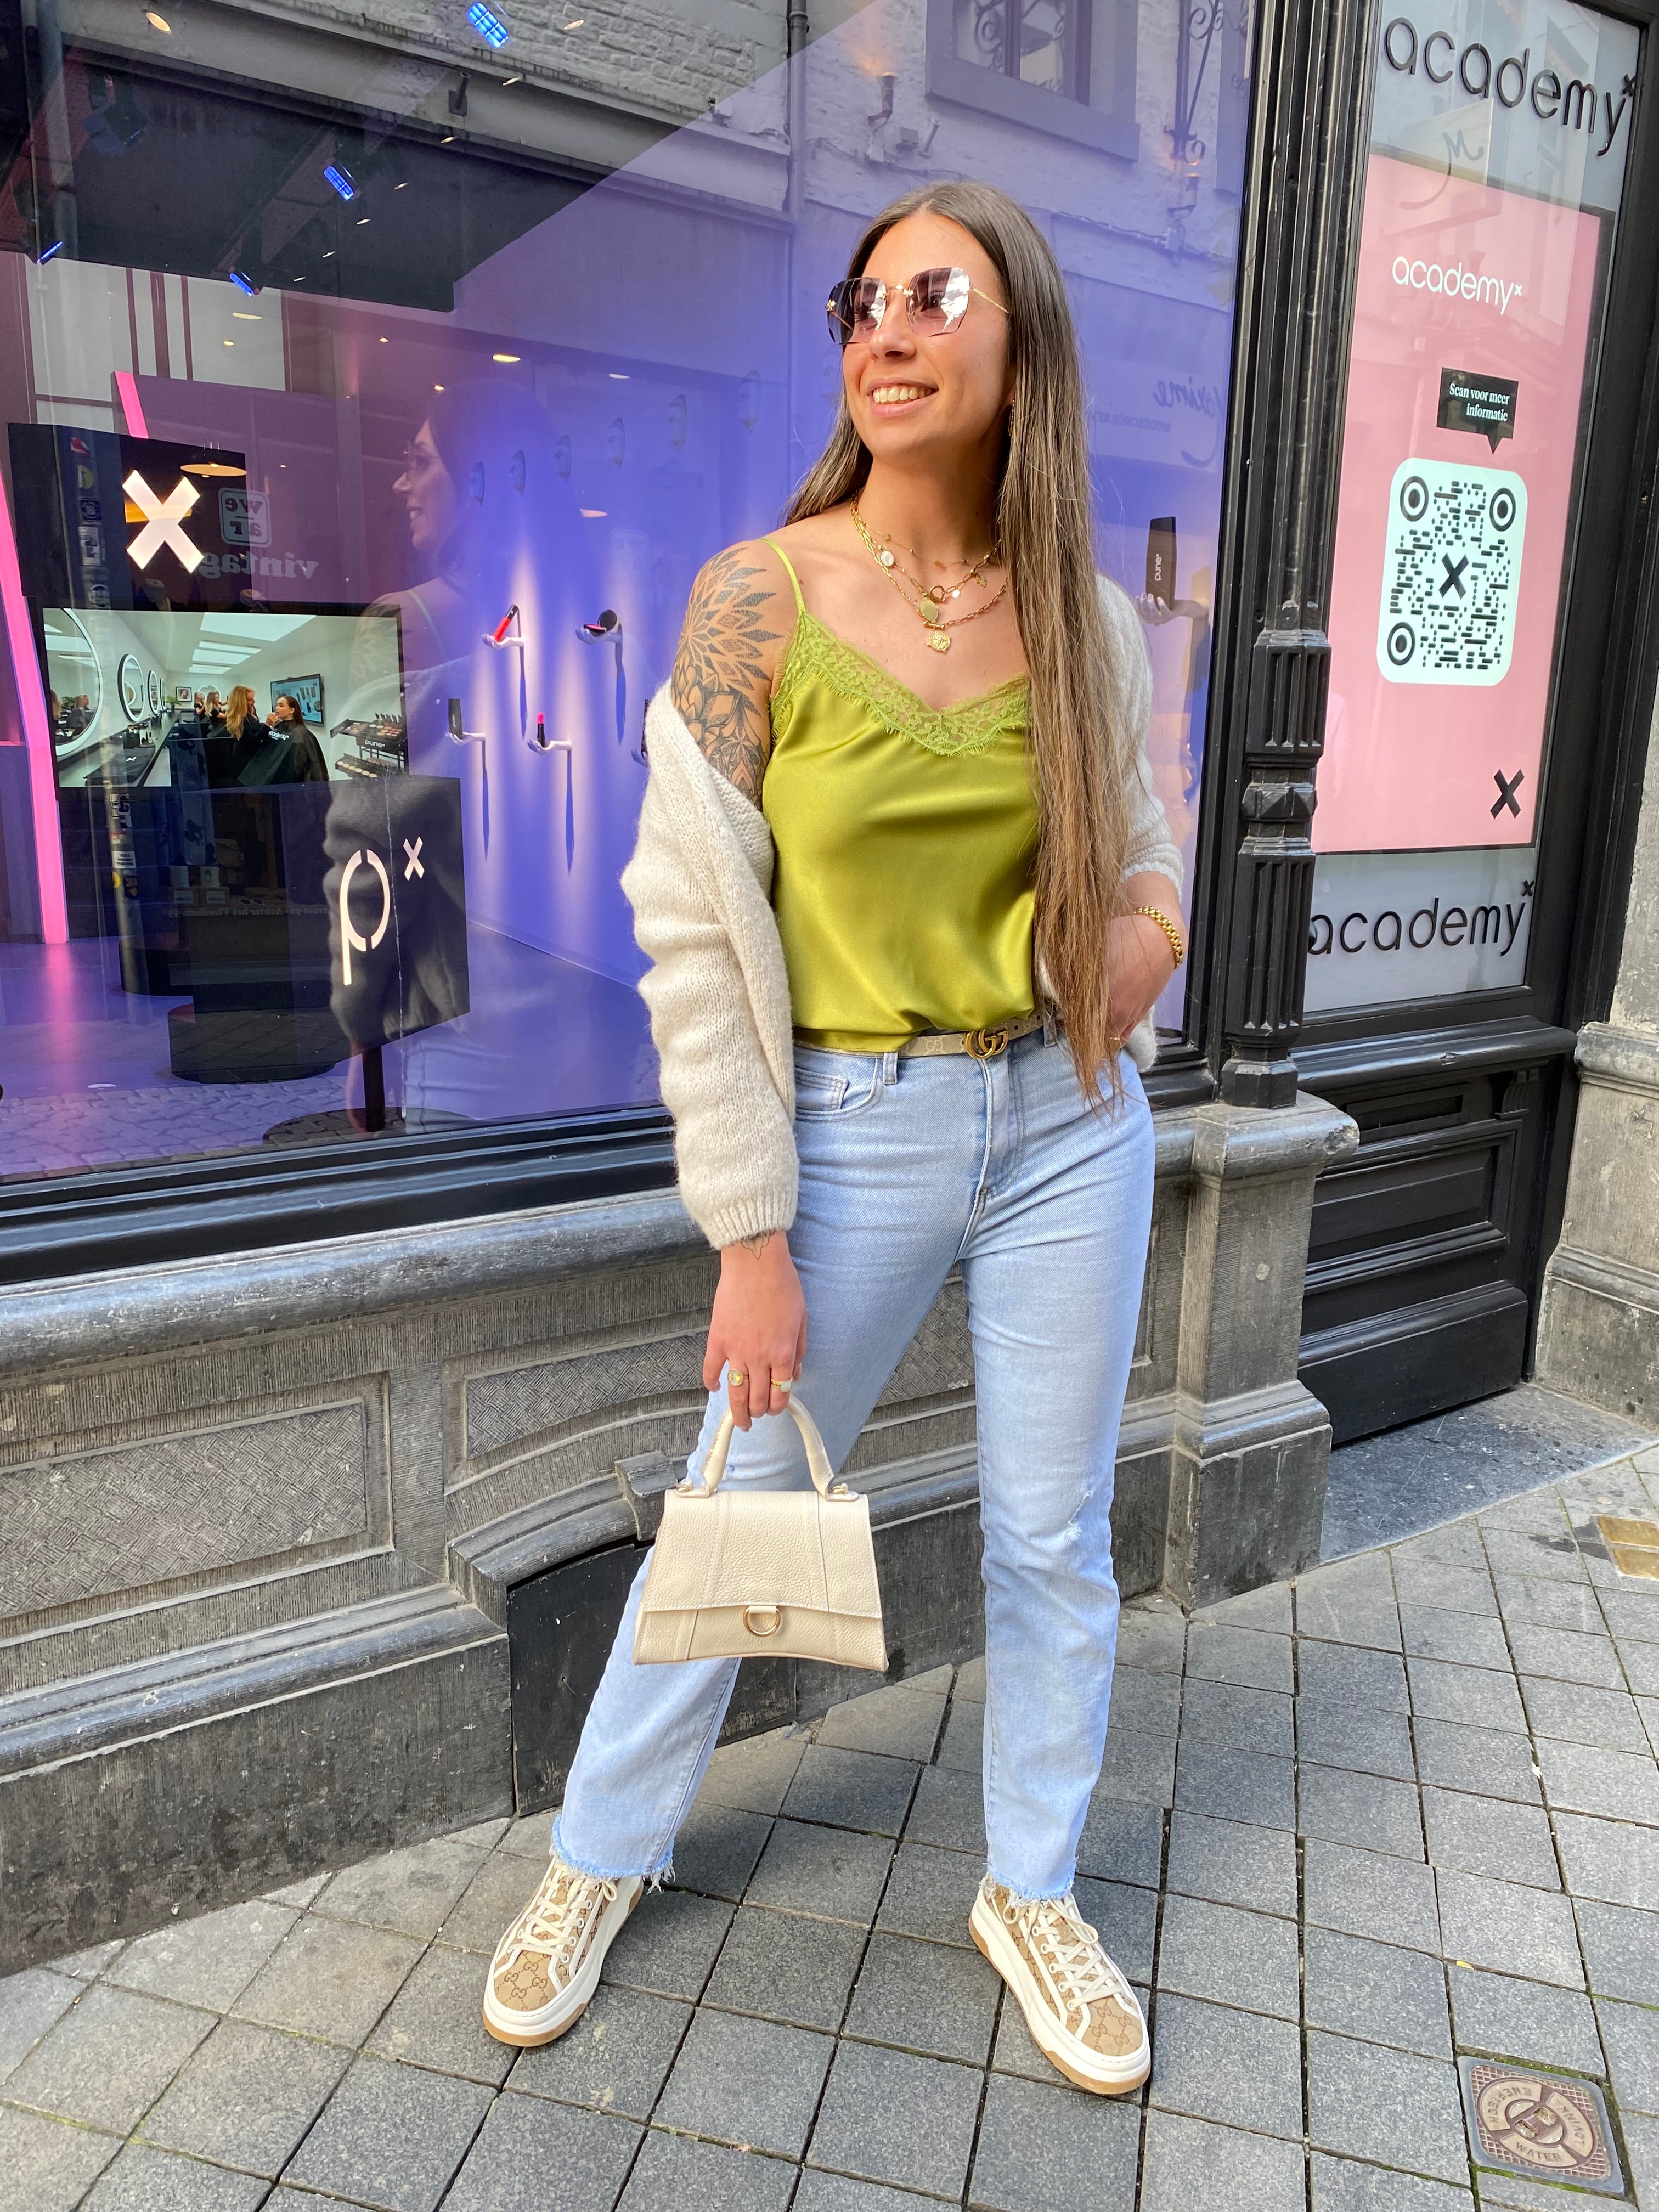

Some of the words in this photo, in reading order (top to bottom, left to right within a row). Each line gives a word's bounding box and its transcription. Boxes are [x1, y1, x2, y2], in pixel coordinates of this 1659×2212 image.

[1449, 383, 1469, 398] Scan
[1470, 389, 1489, 402] voor
[1489, 393, 1510, 405] meer
[1466, 403, 1508, 422] informatie
[1516, 2142, 1563, 2162] WATER
